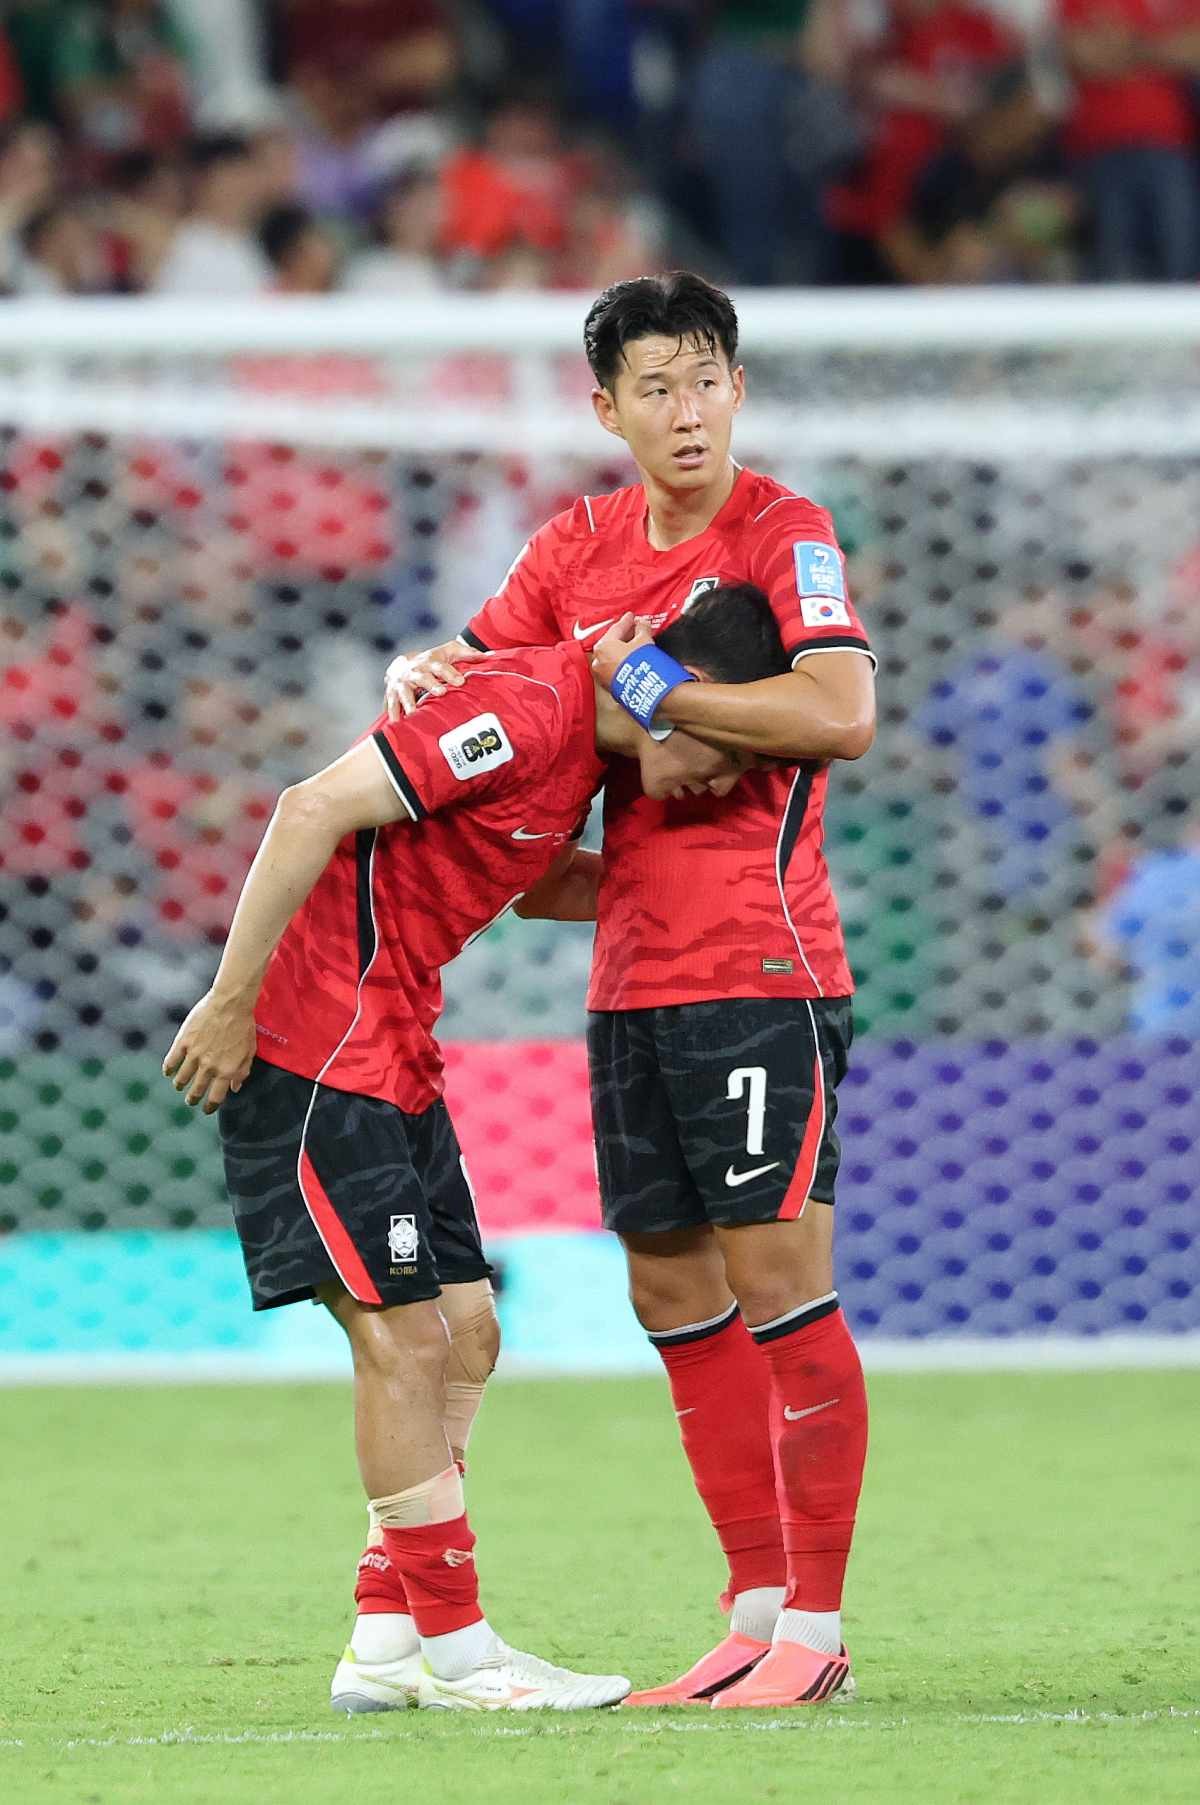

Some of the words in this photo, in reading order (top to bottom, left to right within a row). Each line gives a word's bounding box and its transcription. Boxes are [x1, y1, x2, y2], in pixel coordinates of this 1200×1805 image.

[629, 671, 660, 712] UNITES
[638, 680, 667, 717] FOOTBALL
[725, 1067, 767, 1155] 7
[389, 1266, 417, 1276] KOREA
